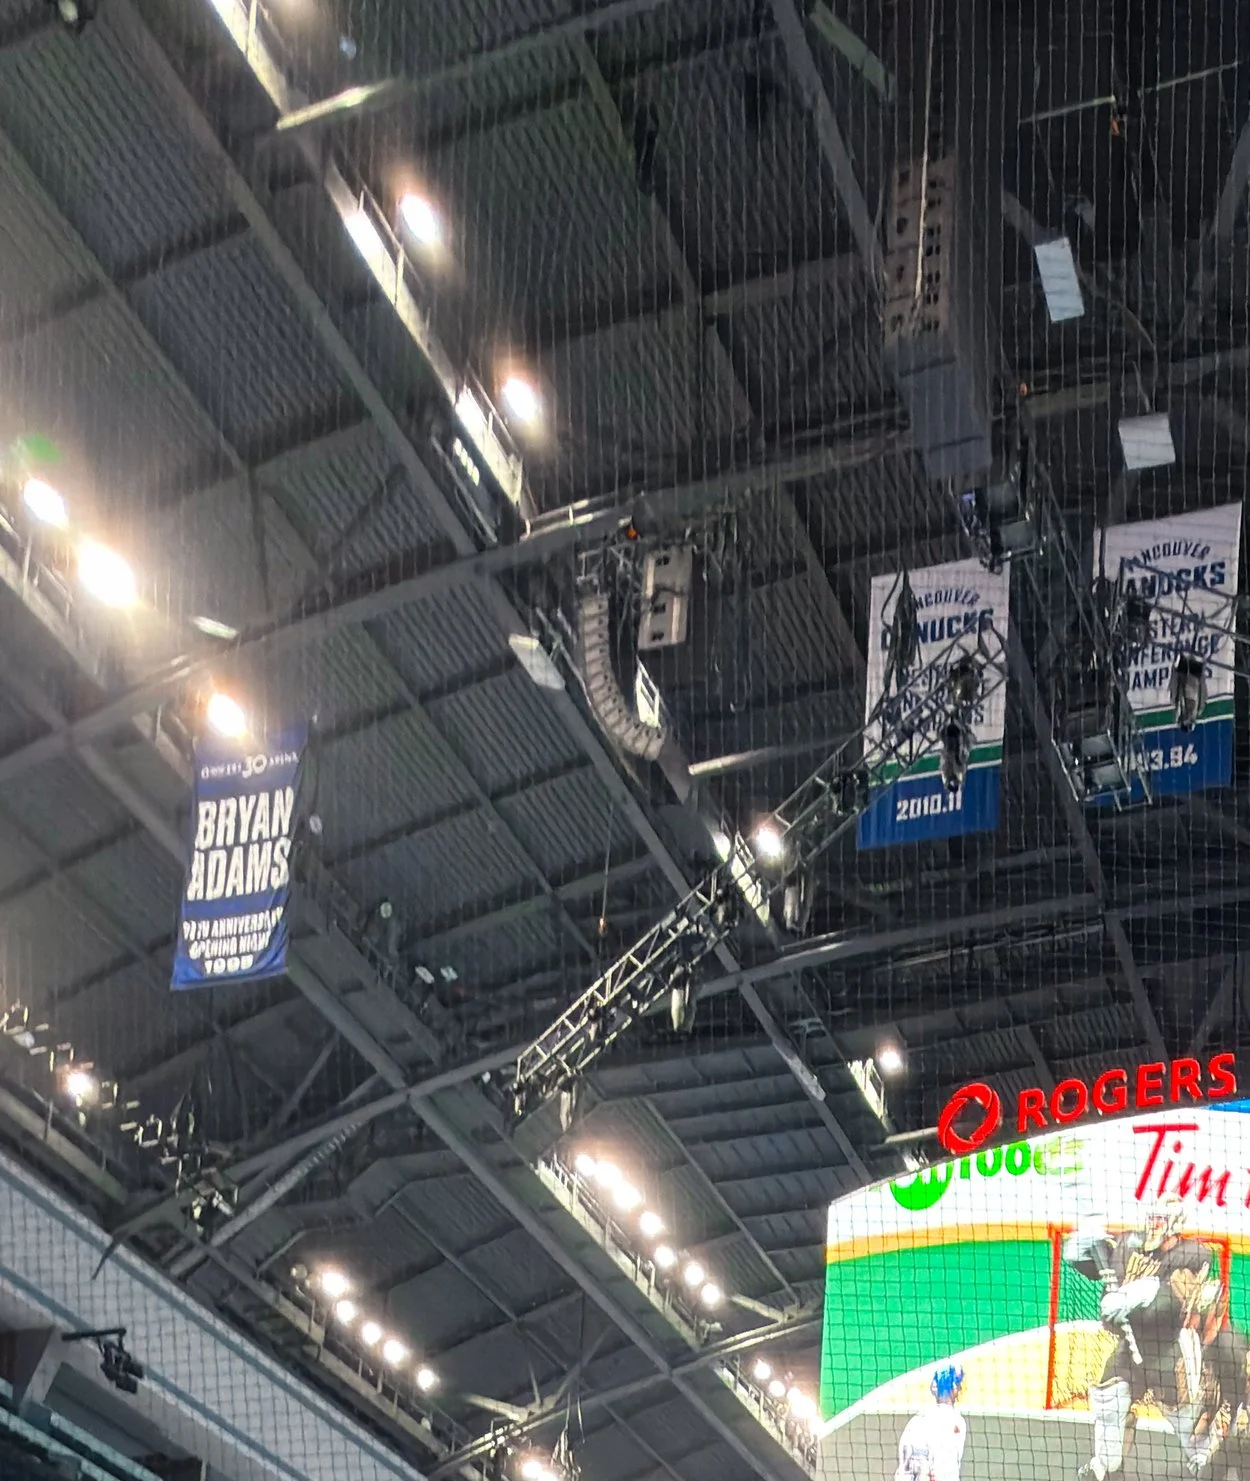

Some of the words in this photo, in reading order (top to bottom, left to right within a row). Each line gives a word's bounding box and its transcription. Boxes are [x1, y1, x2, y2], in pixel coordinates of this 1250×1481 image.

[1124, 561, 1227, 599] ANUCKS
[881, 608, 994, 652] CNUCKS
[195, 785, 294, 850] BRYAN
[186, 837, 292, 901] ADAMS
[1018, 1053, 1237, 1132] ROGERS
[1133, 1122, 1232, 1207] Tim
